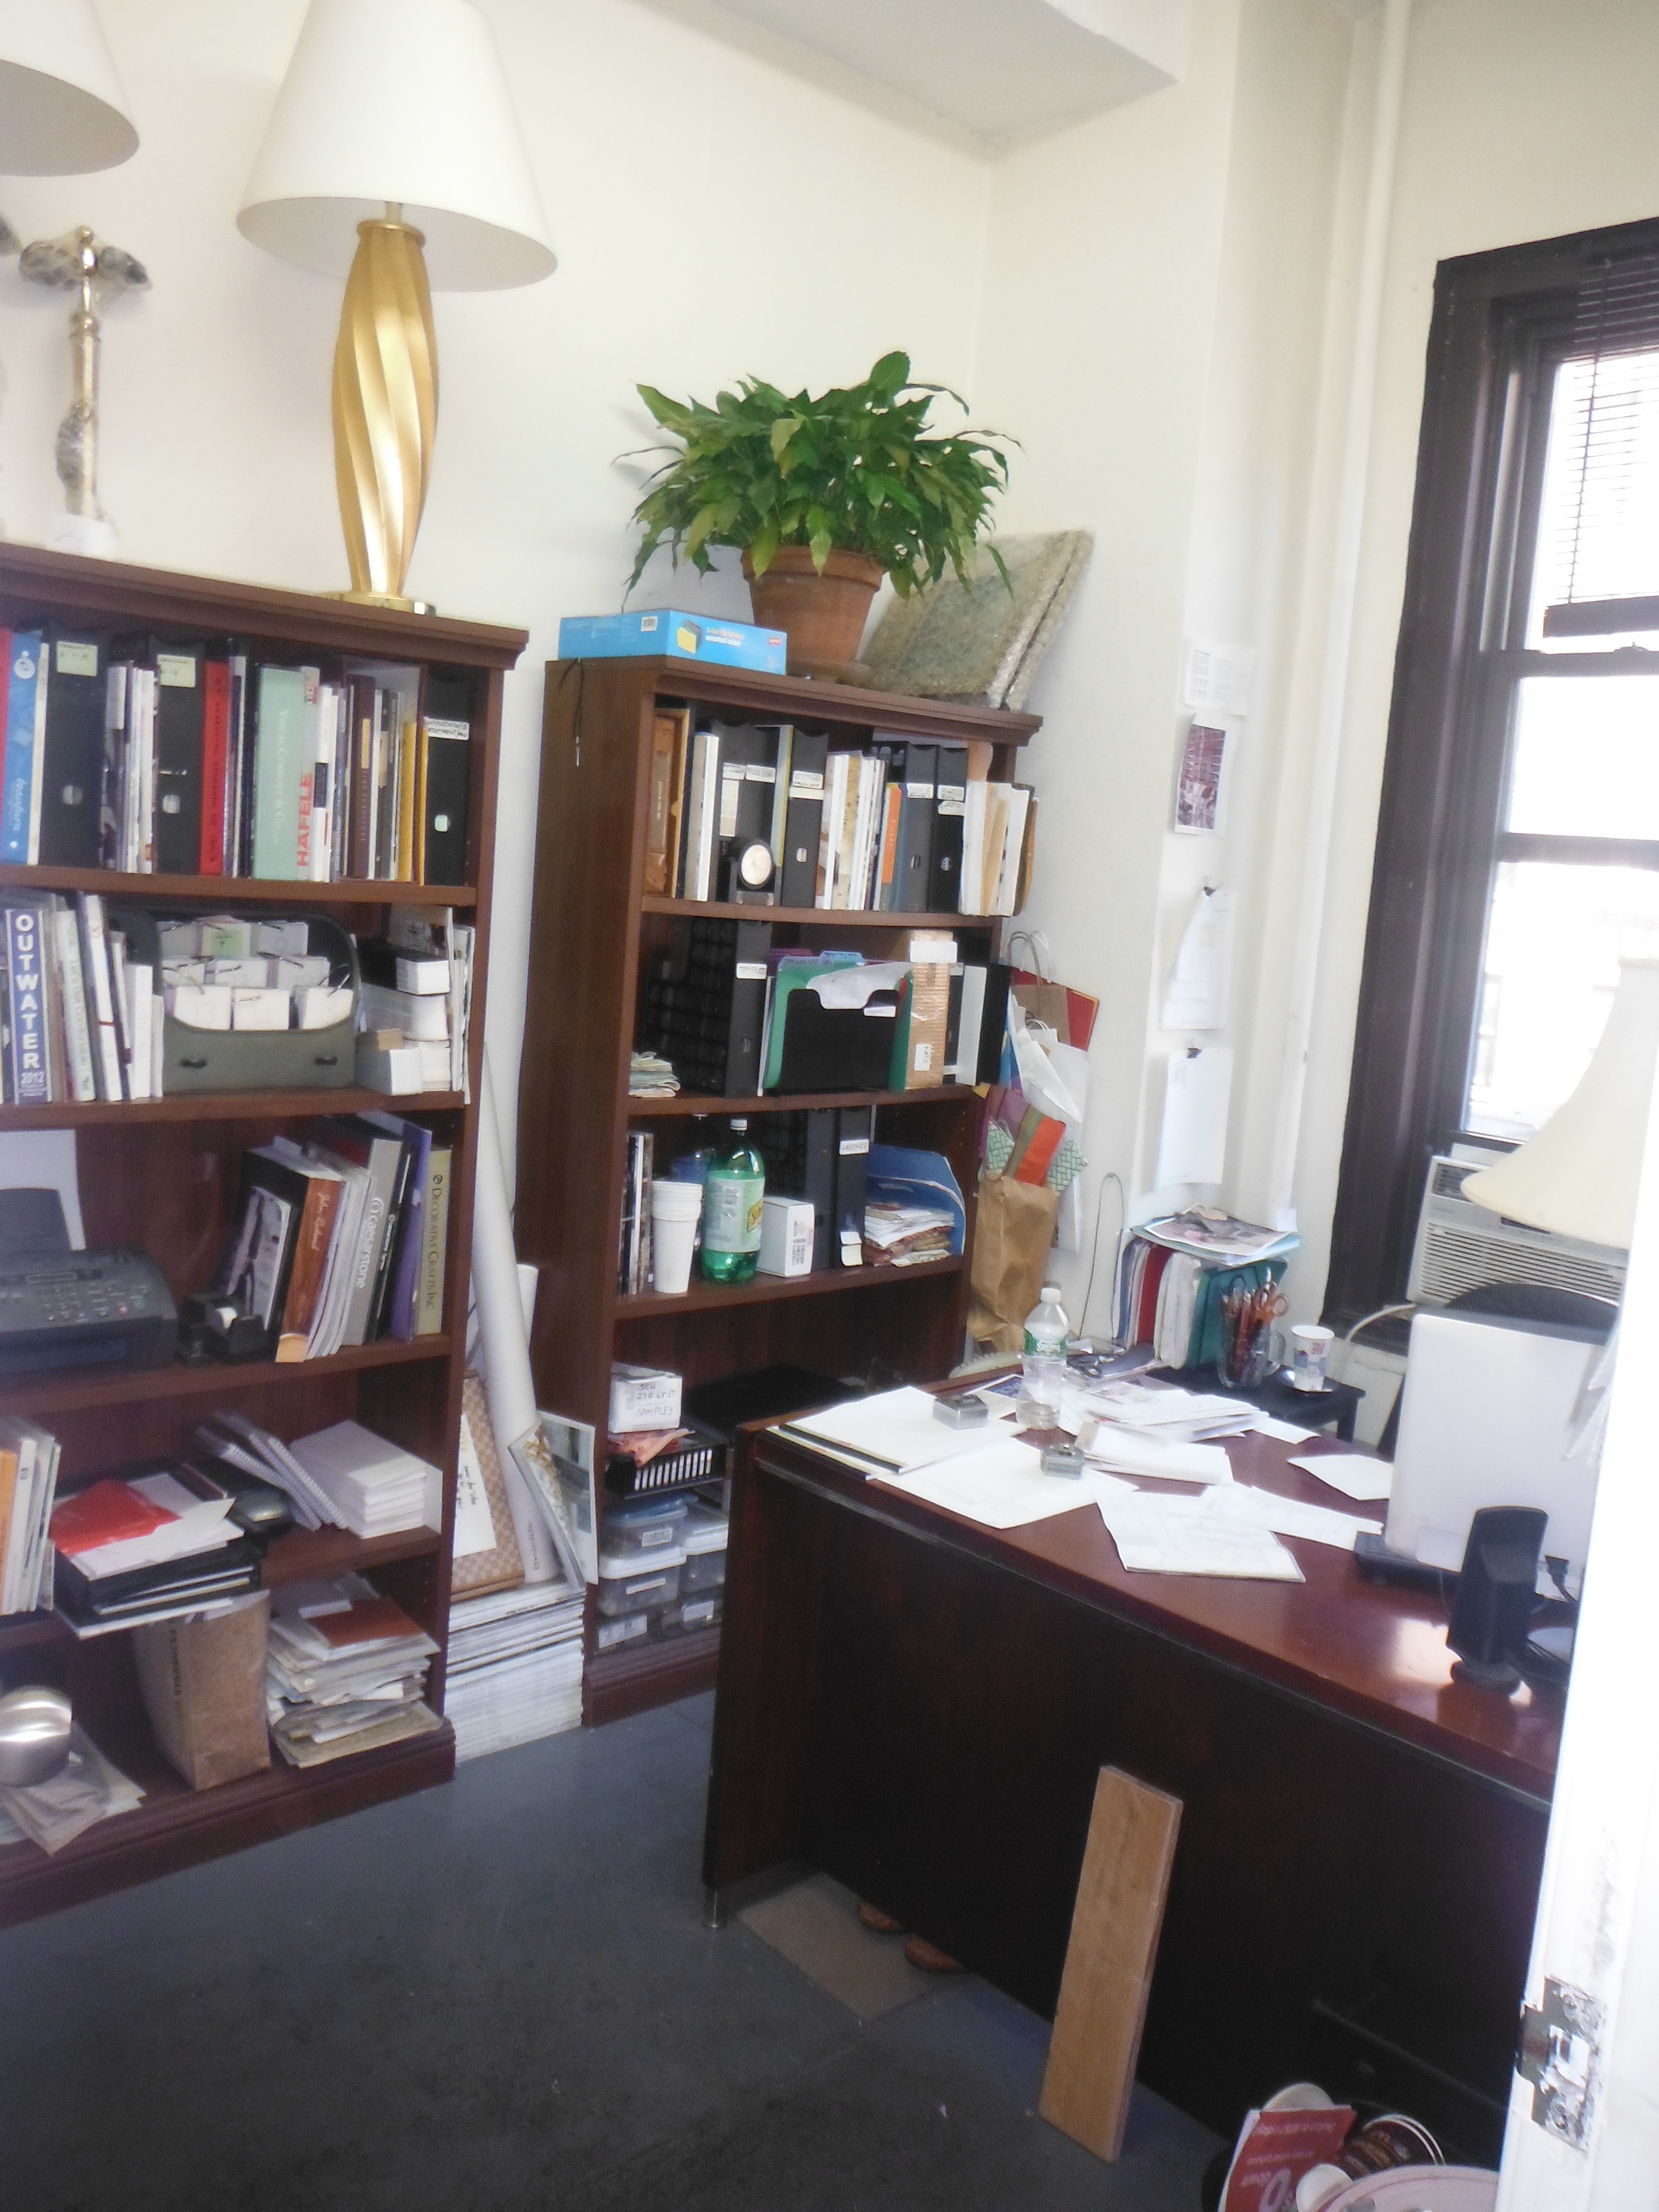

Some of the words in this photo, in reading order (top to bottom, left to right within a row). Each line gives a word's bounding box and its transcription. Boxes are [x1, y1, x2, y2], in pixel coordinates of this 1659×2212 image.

[15, 914, 40, 1069] OUTWATER
[356, 1215, 378, 1289] caesarstone
[636, 1407, 674, 1417] SAMPLES
